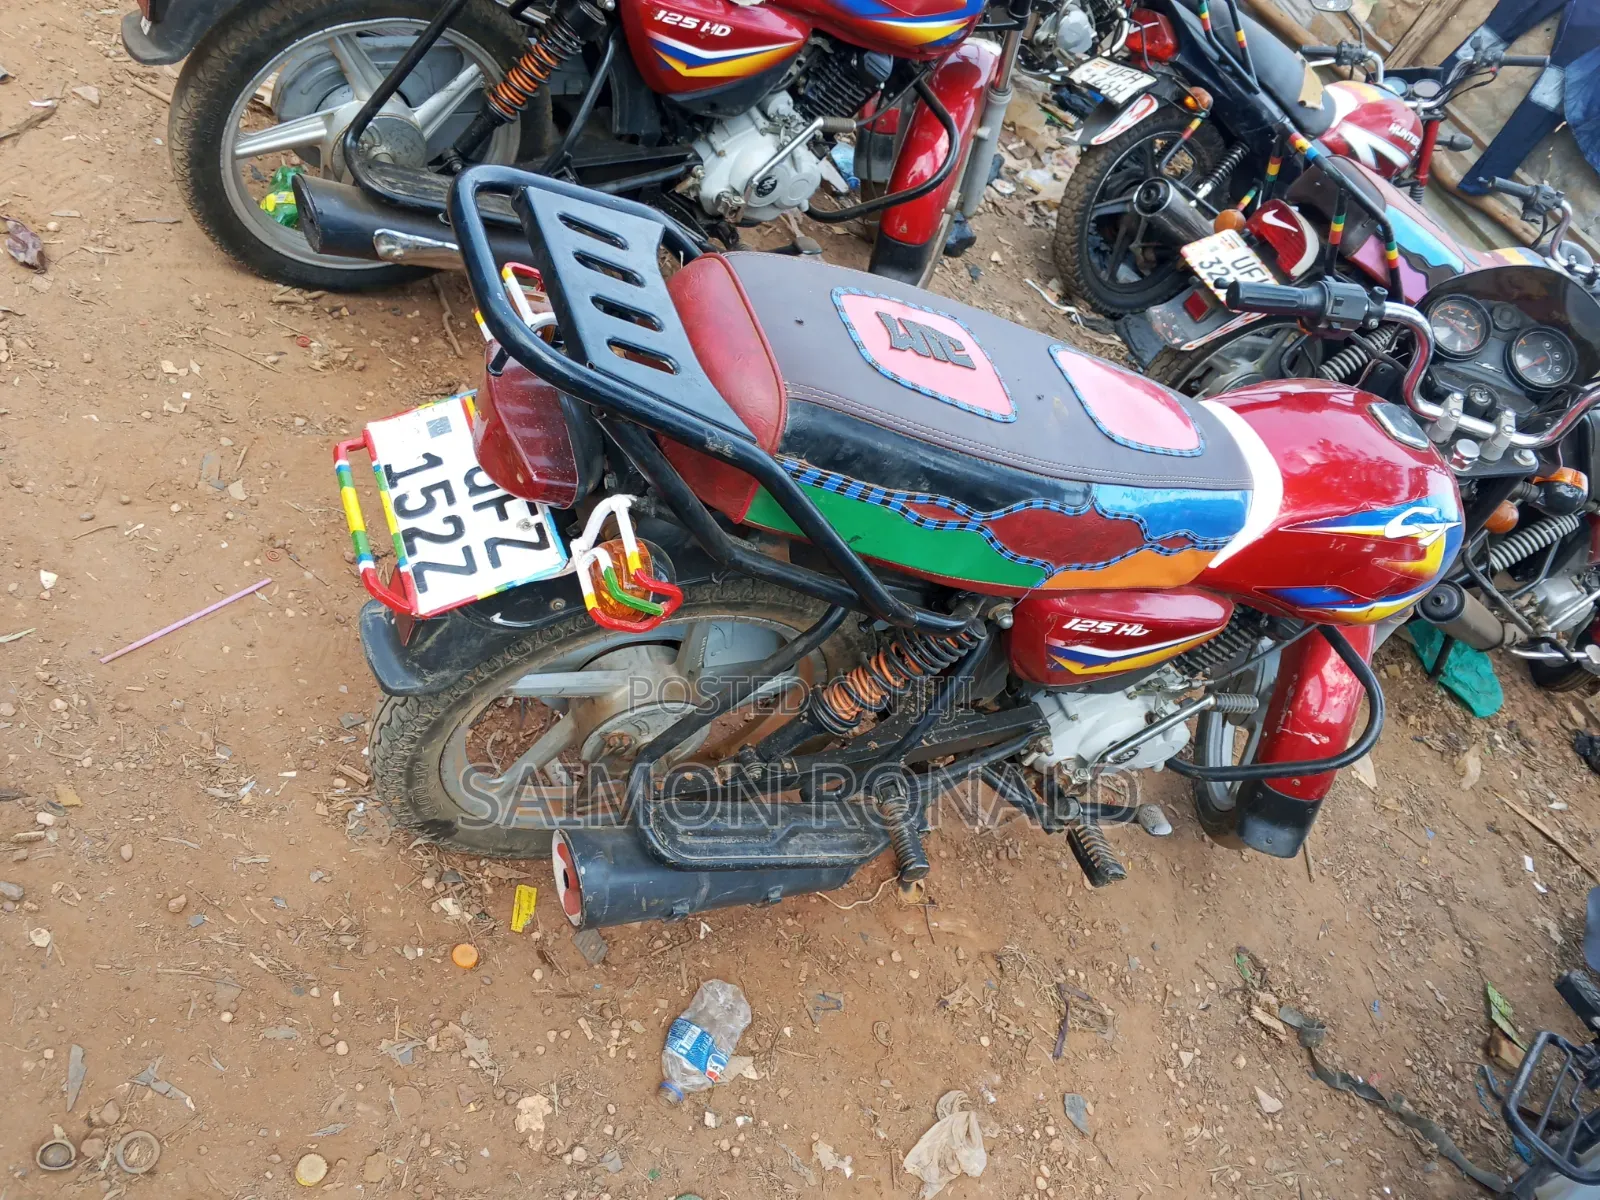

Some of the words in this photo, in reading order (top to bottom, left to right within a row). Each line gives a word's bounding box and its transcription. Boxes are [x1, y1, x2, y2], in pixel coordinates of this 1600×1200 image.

[654, 9, 700, 29] 125
[700, 21, 731, 37] HD
[1198, 256, 1238, 282] 32
[1231, 255, 1269, 283] UF
[383, 452, 478, 594] 152Z
[1062, 618, 1119, 633] 125
